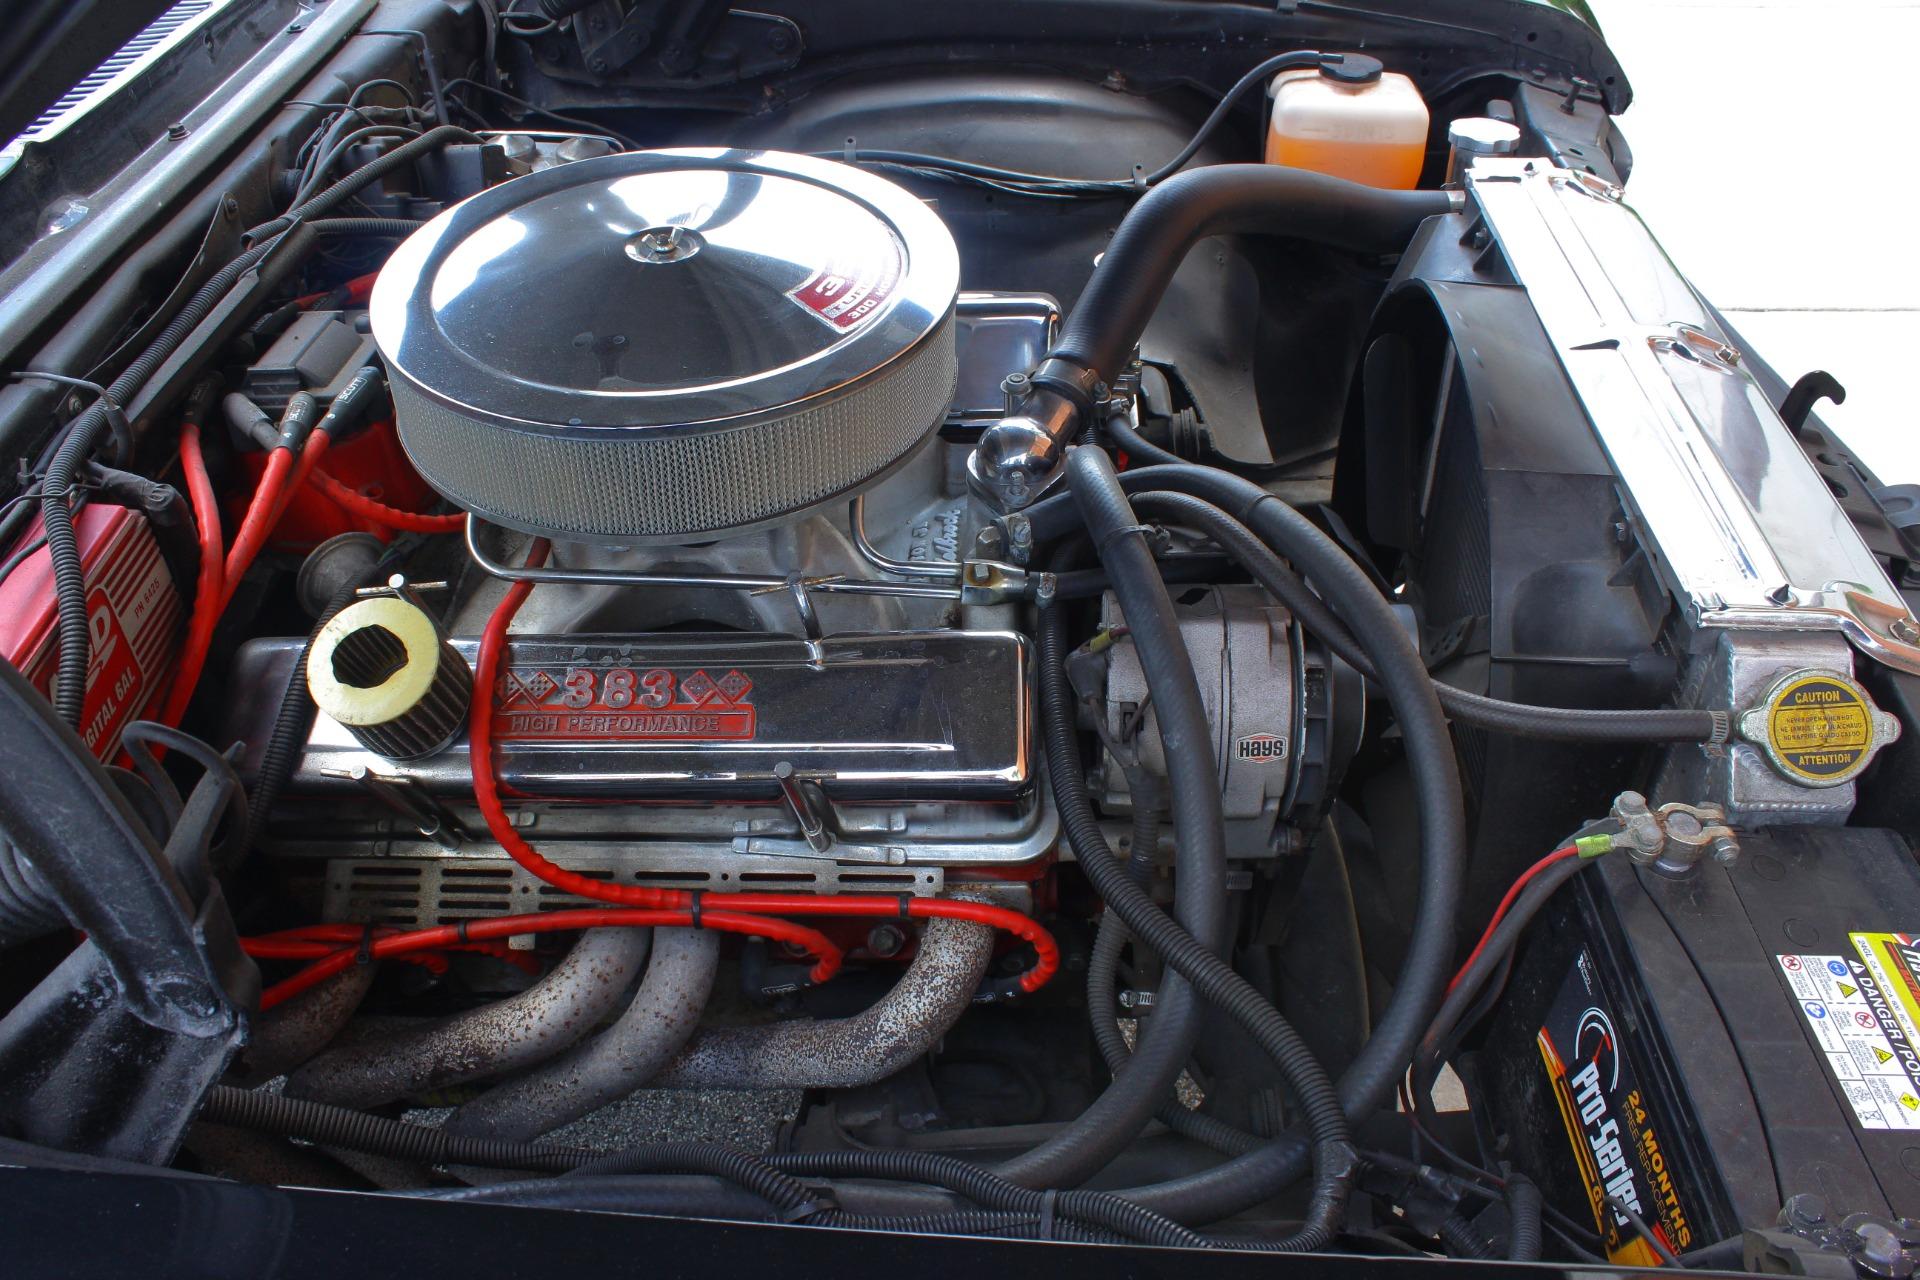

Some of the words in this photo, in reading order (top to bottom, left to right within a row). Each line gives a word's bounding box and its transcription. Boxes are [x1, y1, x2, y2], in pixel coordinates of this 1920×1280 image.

[115, 665, 136, 702] 6AL
[563, 668, 677, 709] 383
[1794, 690, 1841, 704] CAUTION
[511, 715, 559, 733] HIGH
[567, 715, 721, 733] PERFORMANCE
[1798, 753, 1852, 766] ATTENTION
[1858, 977, 1904, 1040] DANGER
[1571, 1061, 1643, 1227] Pro-Series
[1621, 1101, 1640, 1142] FREE
[1635, 1141, 1682, 1256] REPLACEMENT
[1628, 1090, 1647, 1126] 24
[1642, 1128, 1692, 1249] MONTHS
